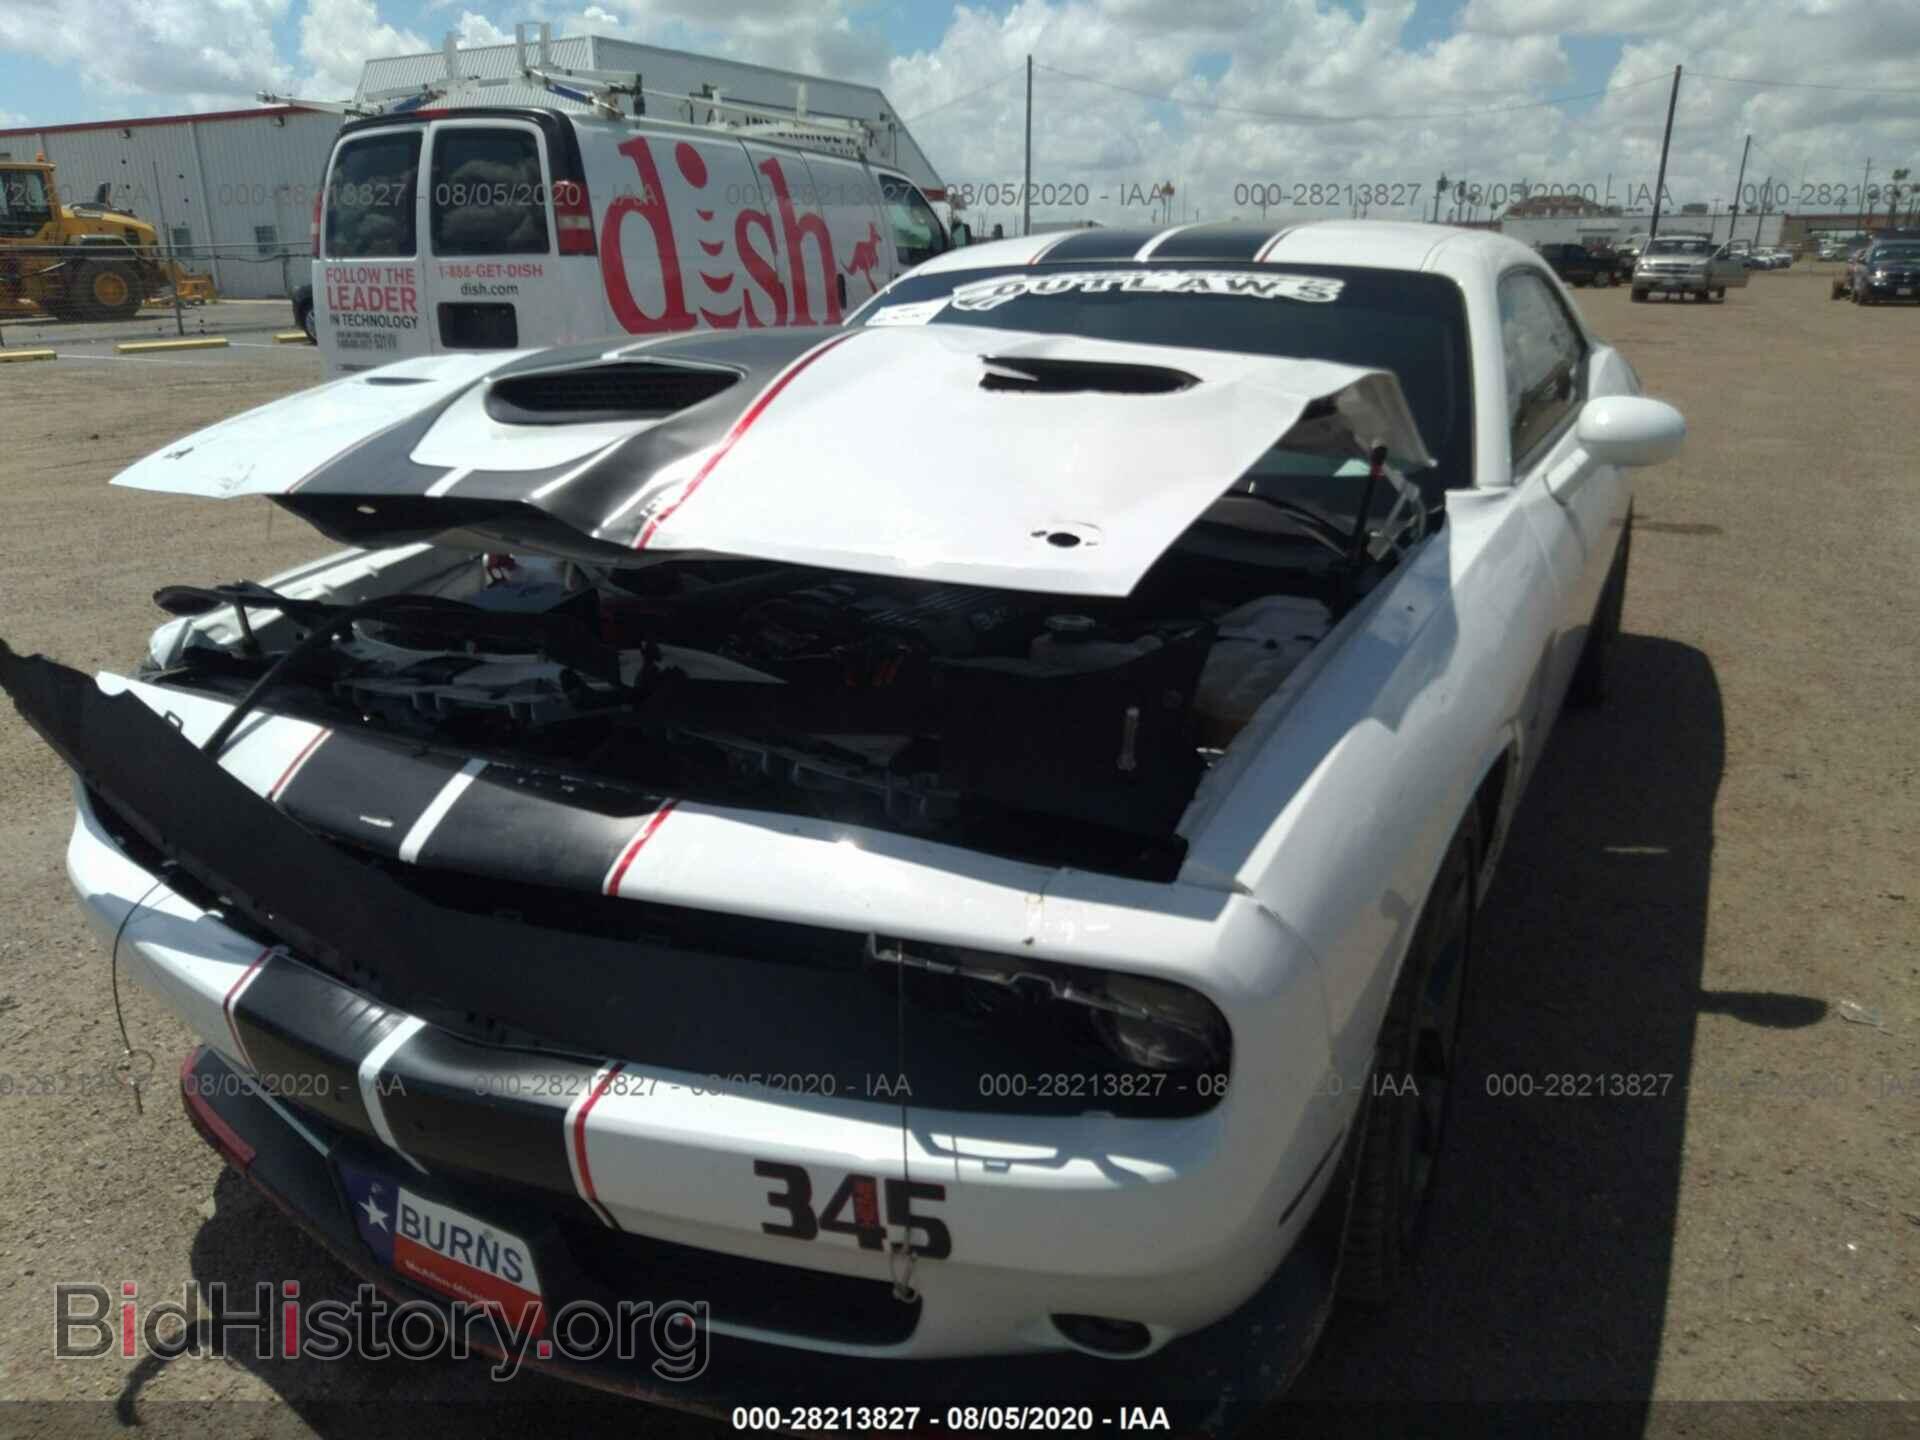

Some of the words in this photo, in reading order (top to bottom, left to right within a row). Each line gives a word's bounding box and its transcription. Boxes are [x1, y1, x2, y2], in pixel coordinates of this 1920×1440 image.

[599, 136, 845, 334] dish
[326, 267, 381, 285] FOLLOW
[387, 268, 415, 286] THE
[460, 281, 519, 297] dish.com
[327, 286, 417, 313] LEADER
[342, 314, 417, 330] TECHNOLOGY
[753, 1159, 952, 1260] 345
[400, 1202, 523, 1283] BURNS
